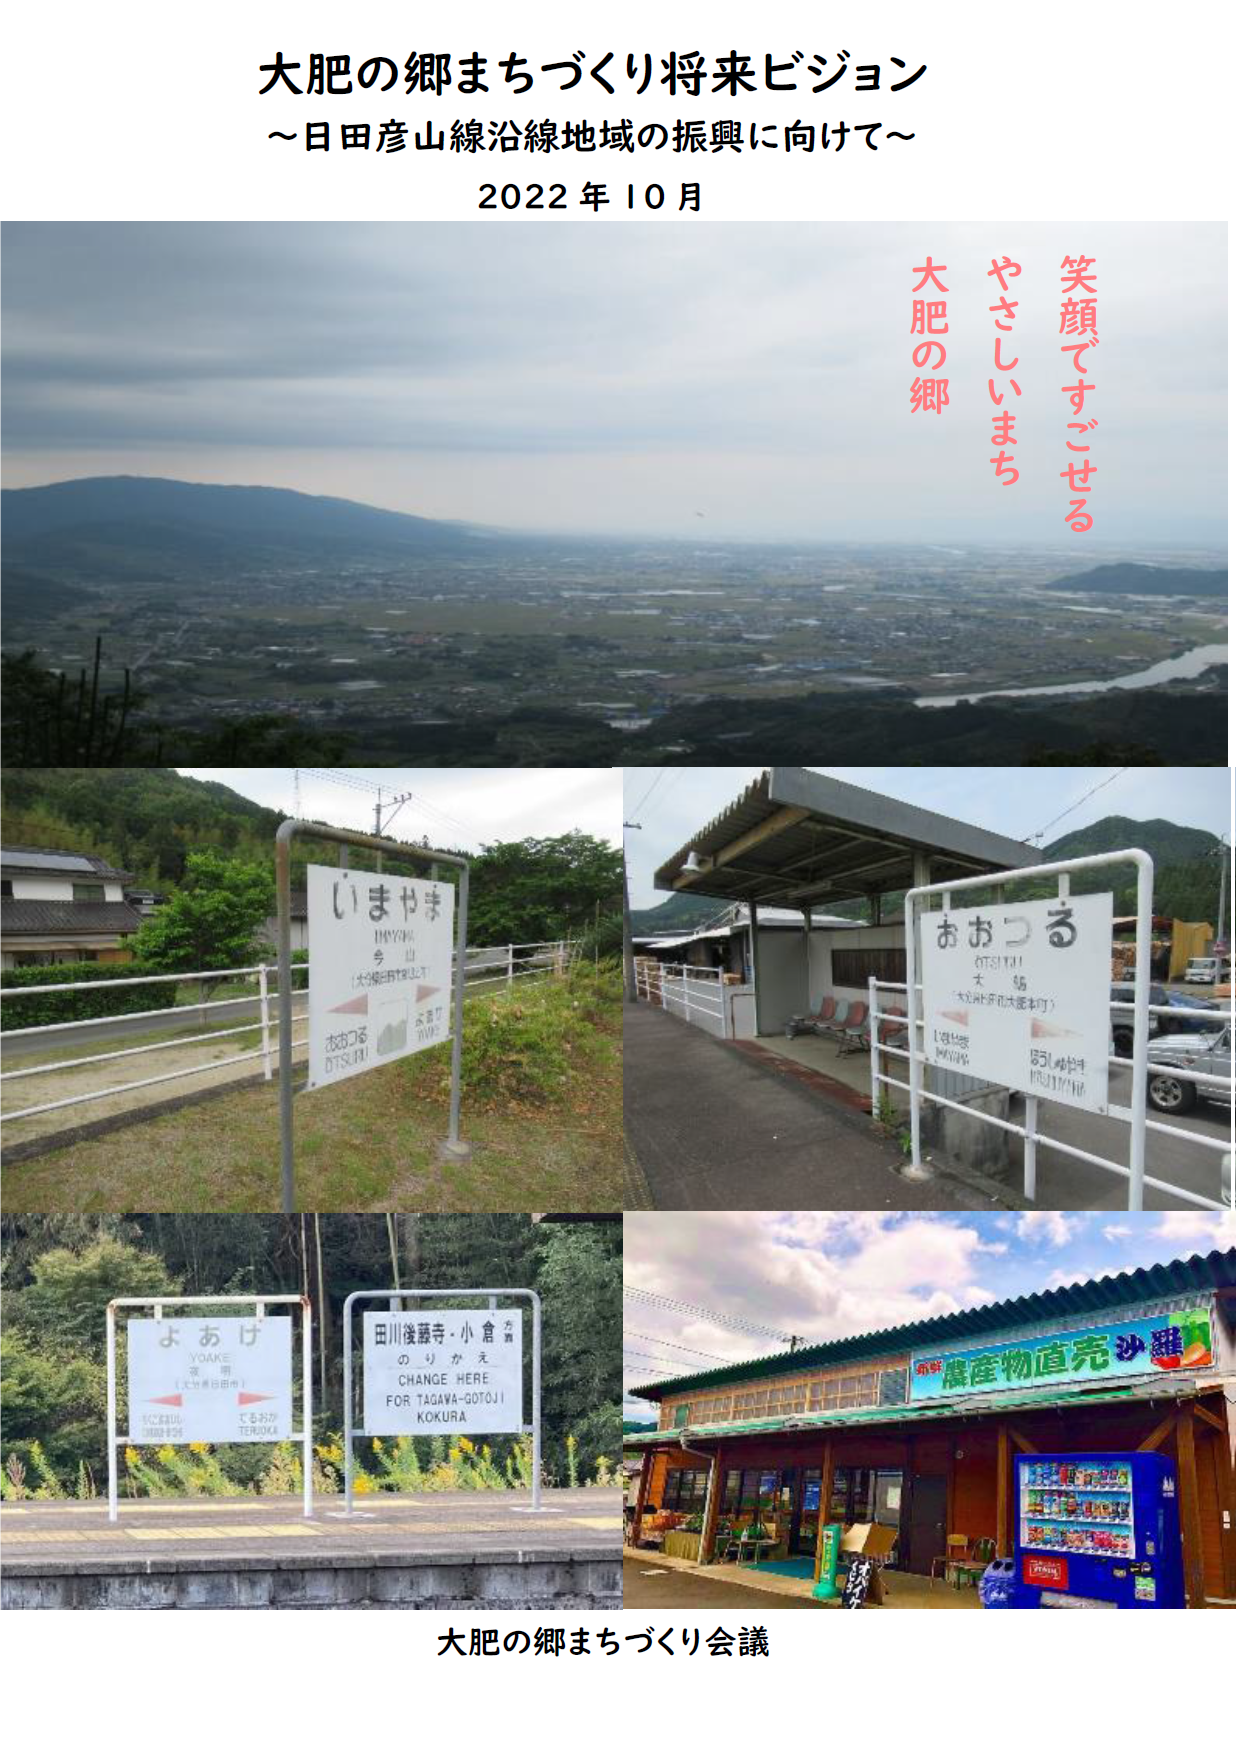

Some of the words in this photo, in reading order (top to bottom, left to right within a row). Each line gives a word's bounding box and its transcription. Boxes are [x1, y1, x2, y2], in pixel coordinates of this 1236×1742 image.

[332, 881, 442, 922] いまやま
[936, 907, 1079, 950] おおつる
[324, 1025, 368, 1053] おおつる
[158, 1324, 262, 1348] よあけ
[189, 1352, 232, 1363] YOAKE
[397, 1352, 490, 1366] のりかえ
[941, 1333, 1110, 1391] 農産物直売
[1114, 1325, 1185, 1363] 沙羅
[398, 1373, 448, 1387] CHANGE
[456, 1372, 490, 1386] HERE
[386, 1395, 411, 1407] FOR
[417, 1411, 467, 1424] KOKURA
